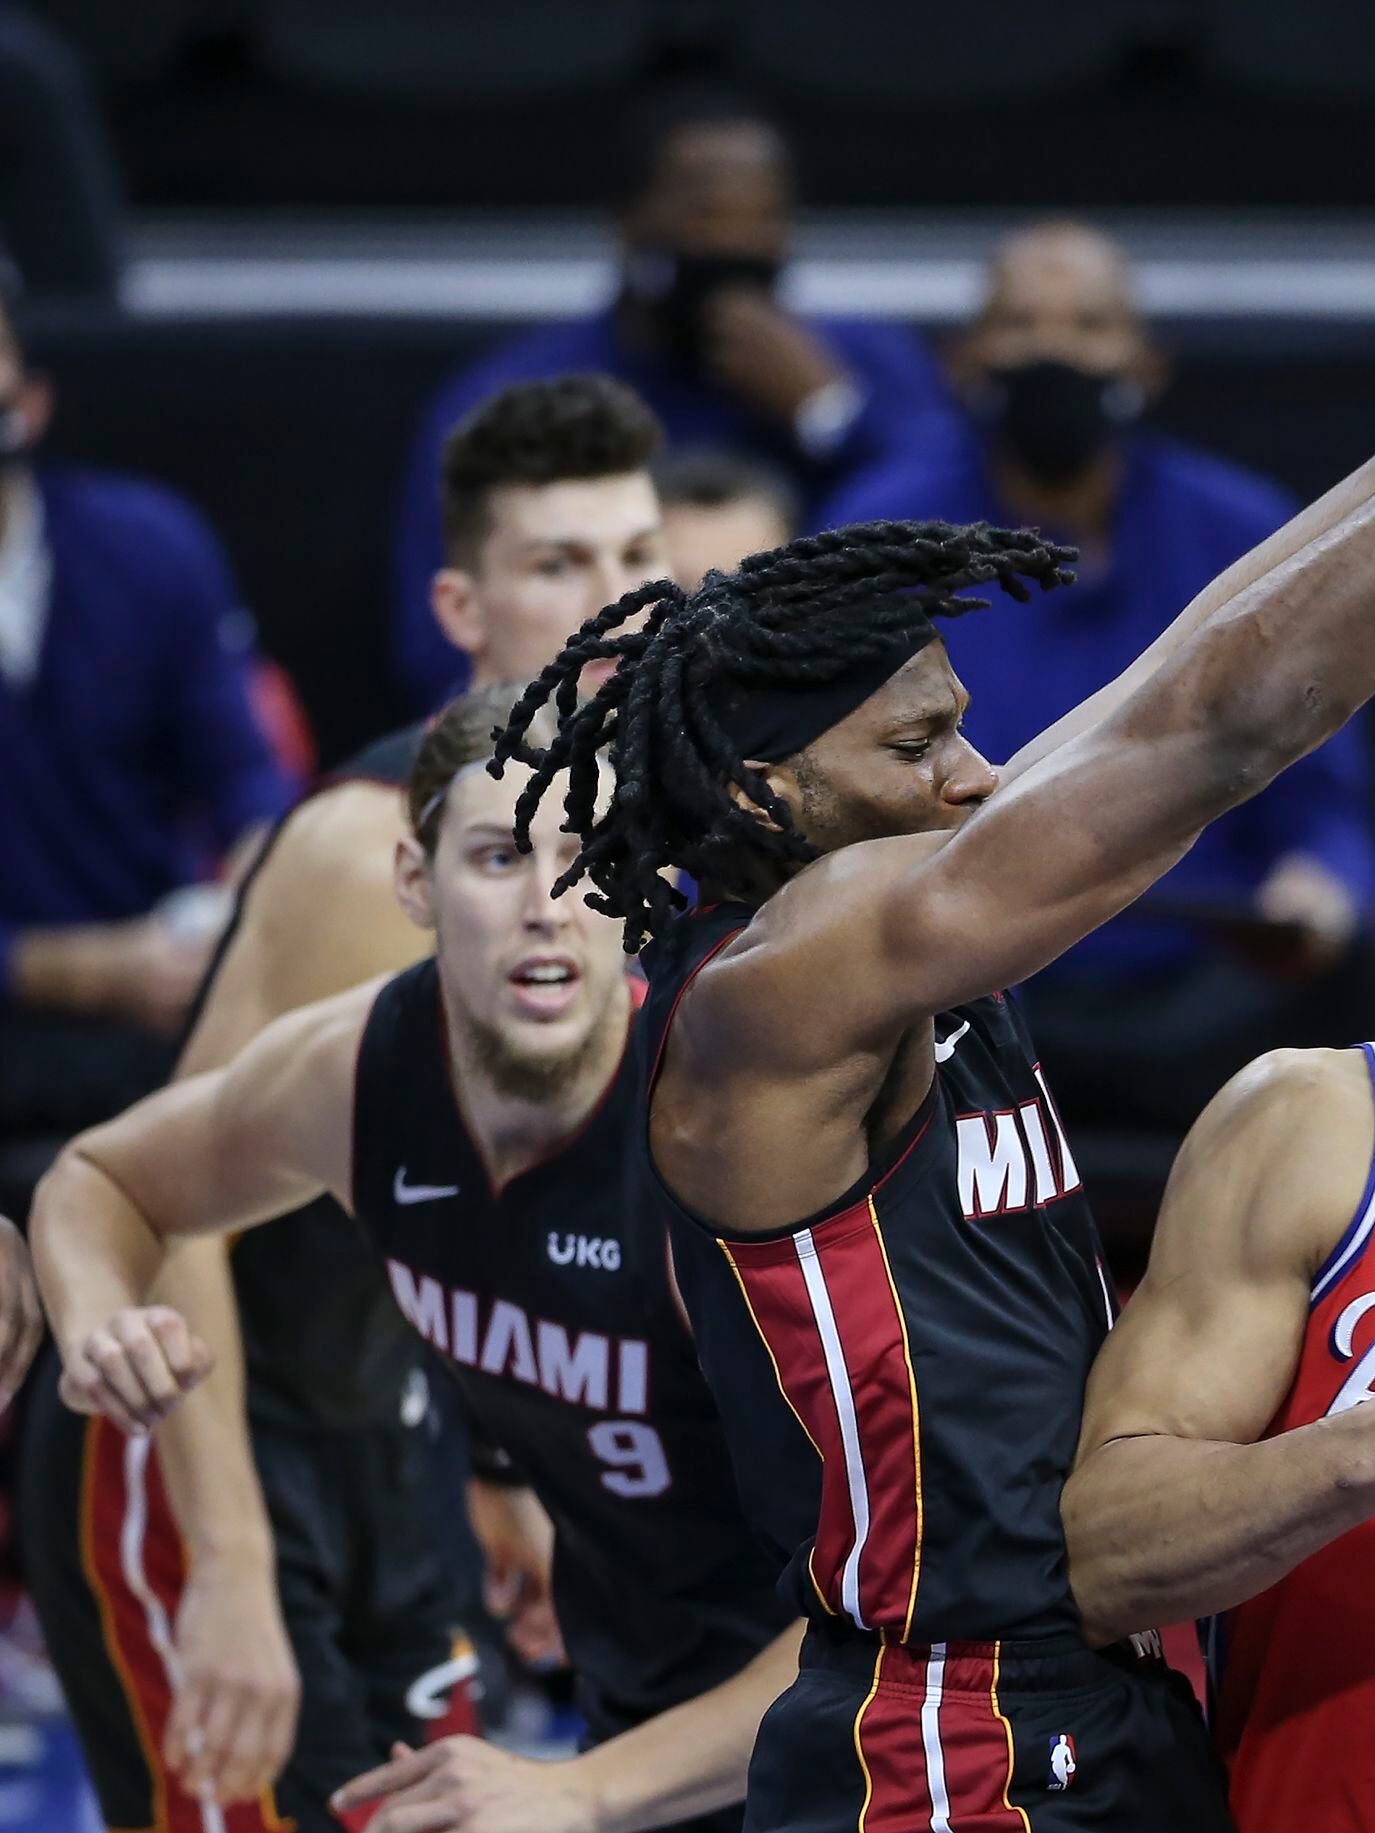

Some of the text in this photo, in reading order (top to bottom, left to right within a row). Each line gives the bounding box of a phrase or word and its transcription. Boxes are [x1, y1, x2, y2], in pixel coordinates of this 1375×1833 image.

[546, 1231, 622, 1272] UKG
[385, 1256, 648, 1415] MIAMI
[587, 1419, 673, 1499] 9
